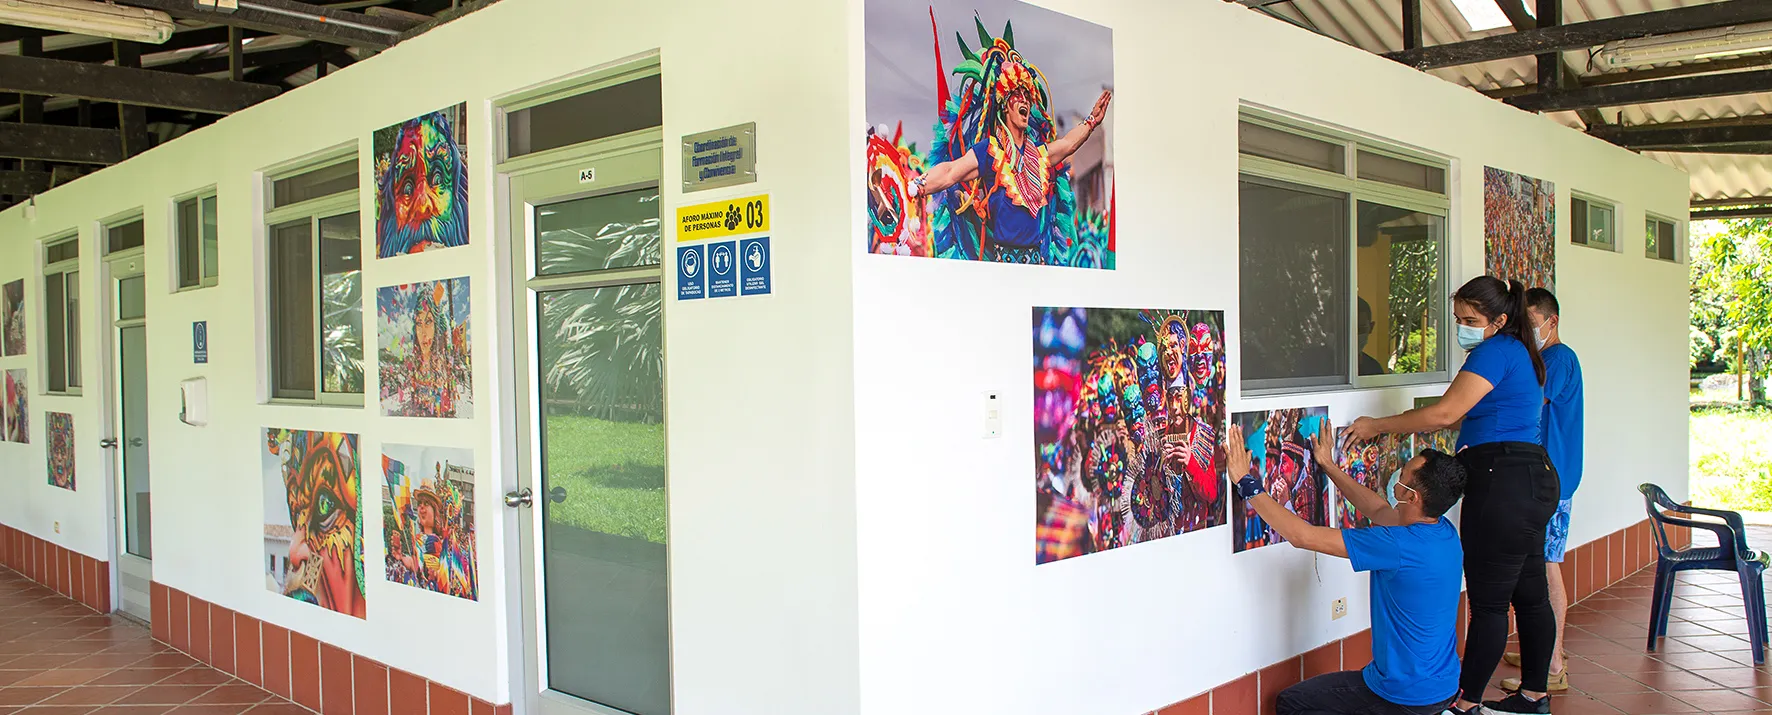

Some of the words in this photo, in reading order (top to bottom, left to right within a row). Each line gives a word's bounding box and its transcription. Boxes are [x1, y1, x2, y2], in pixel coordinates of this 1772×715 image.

[728, 135, 737, 146] de
[720, 147, 743, 162] Integral
[580, 170, 593, 181] A-5
[682, 214, 700, 223] AFORO
[701, 211, 723, 220] MÁXIMO
[746, 200, 763, 229] 03
[684, 224, 692, 232] DE
[693, 221, 721, 231] PERSONAS
